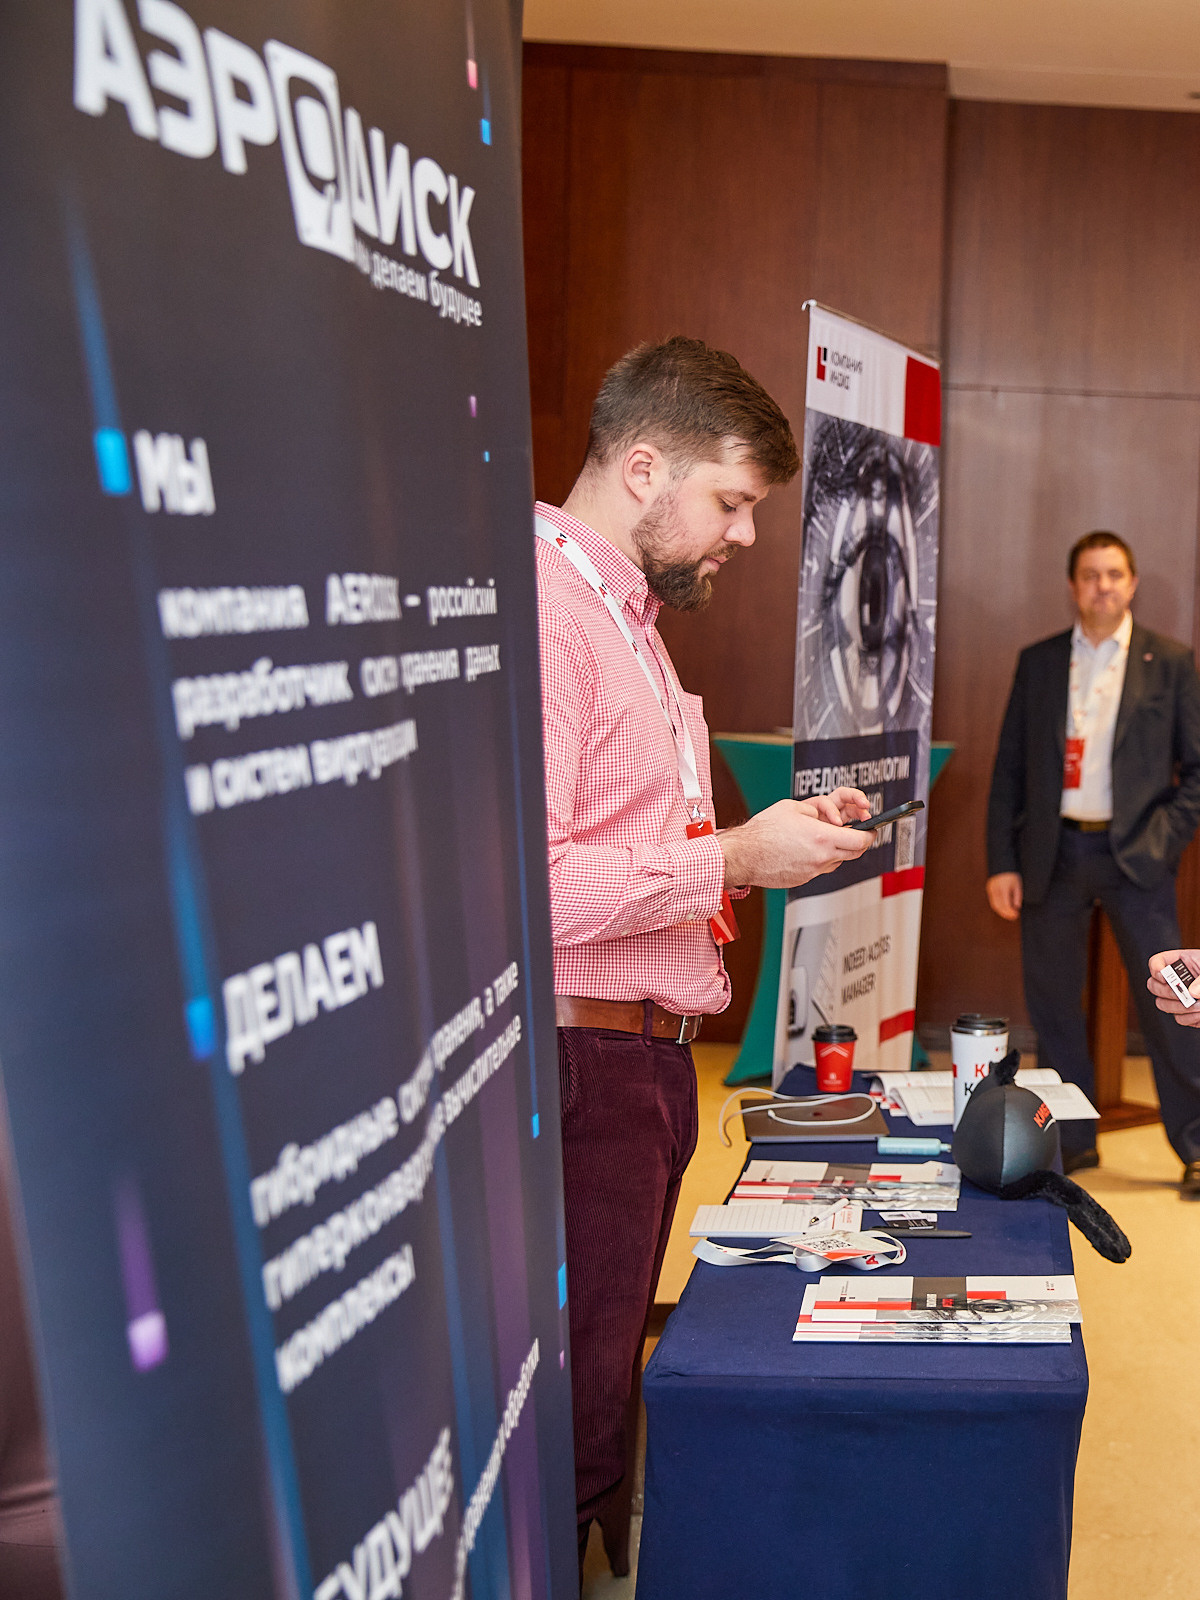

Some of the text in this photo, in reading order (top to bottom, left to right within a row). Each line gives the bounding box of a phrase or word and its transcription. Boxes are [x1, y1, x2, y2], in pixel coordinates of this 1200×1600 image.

[135, 429, 216, 516] МЫ
[427, 577, 498, 626] российский
[172, 656, 354, 741] разработчик
[222, 921, 384, 1076] ДЕЛАЕМ
[275, 1242, 417, 1396] комплексы
